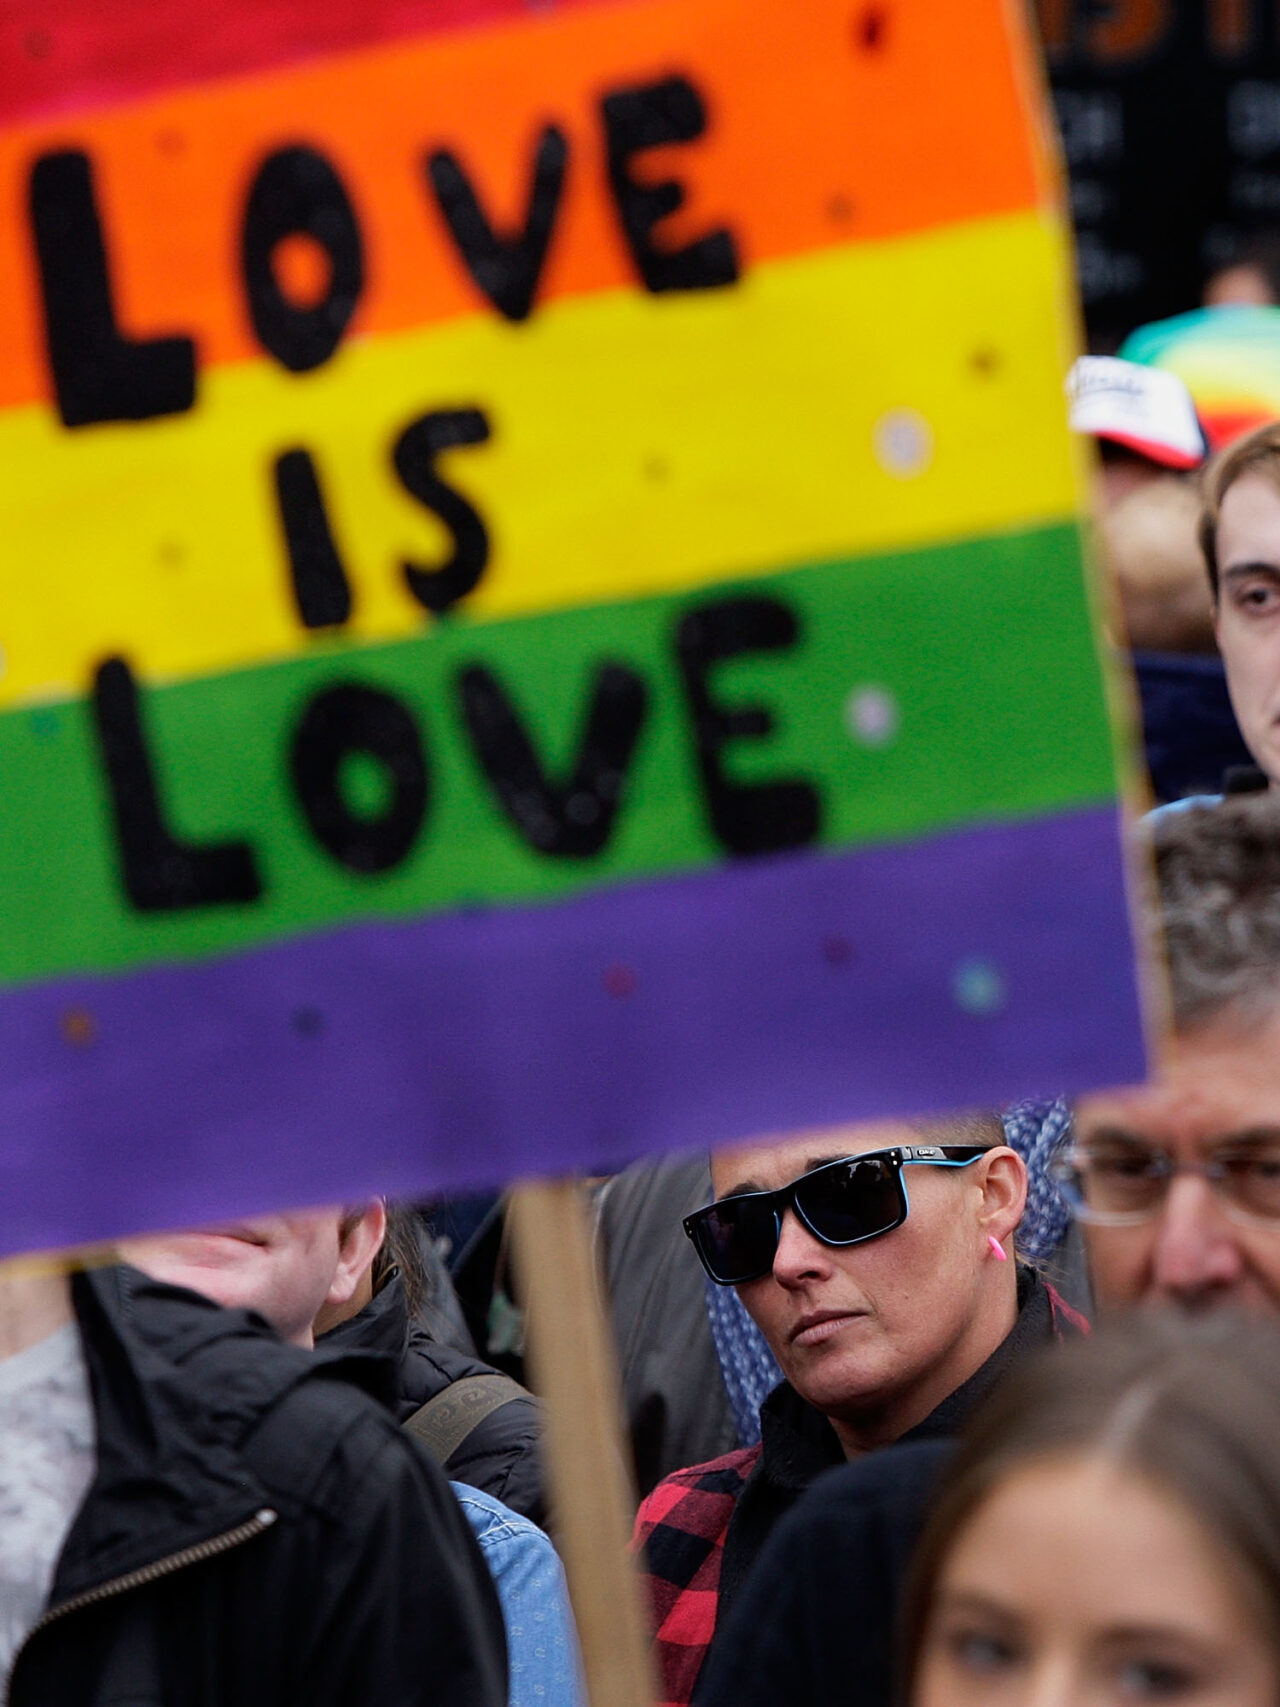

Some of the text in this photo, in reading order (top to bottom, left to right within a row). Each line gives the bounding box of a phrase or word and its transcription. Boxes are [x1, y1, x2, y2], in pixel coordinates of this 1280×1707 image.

[29, 74, 741, 430] LOVE
[273, 406, 492, 632] IS
[84, 588, 829, 916] LOVE
